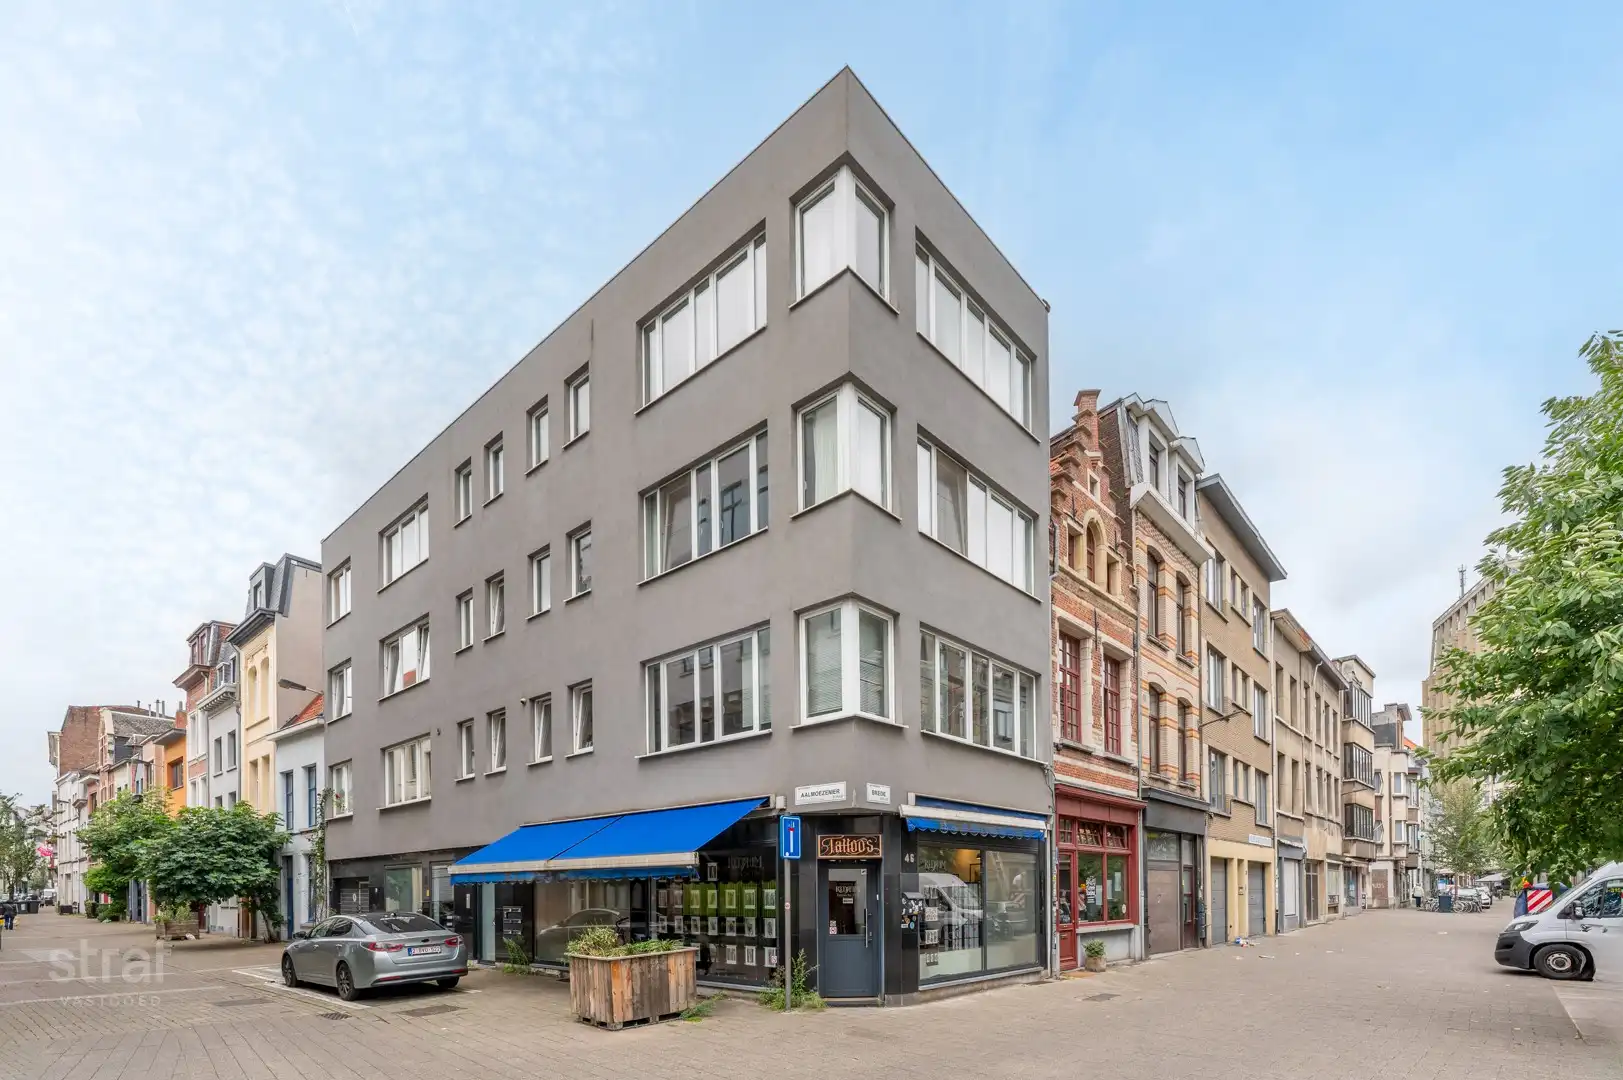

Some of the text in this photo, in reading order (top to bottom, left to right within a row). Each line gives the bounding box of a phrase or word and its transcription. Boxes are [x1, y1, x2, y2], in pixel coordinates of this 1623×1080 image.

[800, 788, 841, 799] AALMOEZENIER
[871, 789, 887, 798] BREDE
[904, 853, 915, 863] 46
